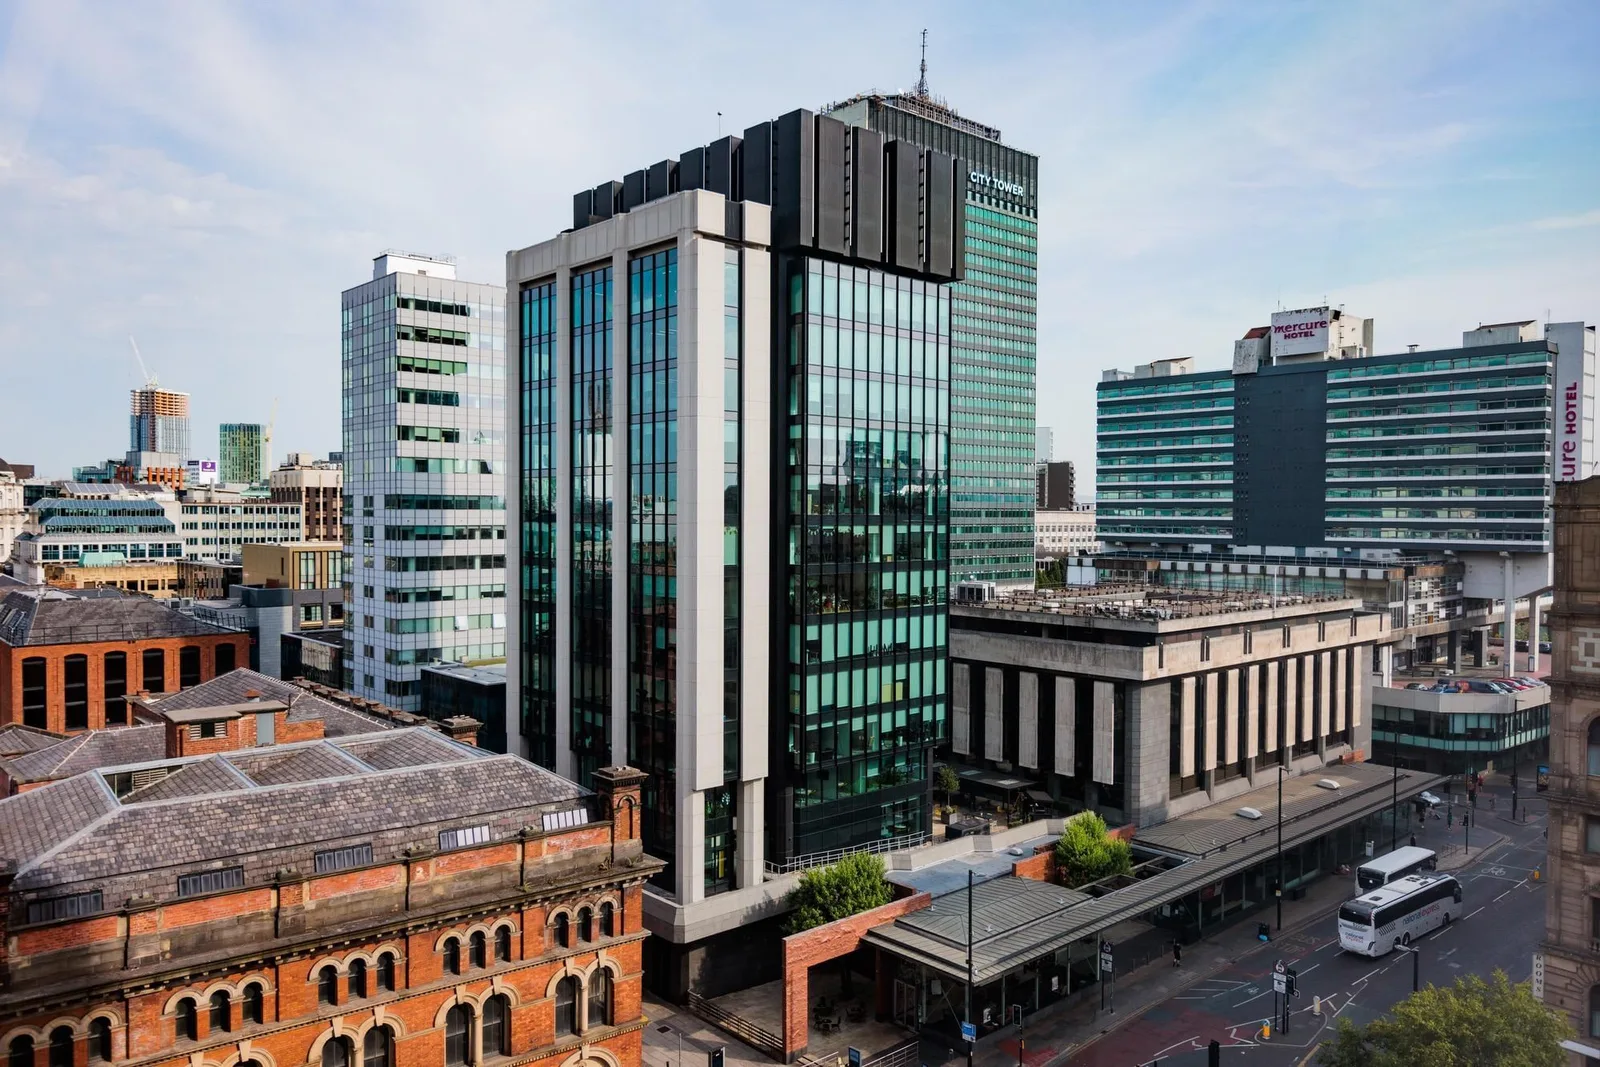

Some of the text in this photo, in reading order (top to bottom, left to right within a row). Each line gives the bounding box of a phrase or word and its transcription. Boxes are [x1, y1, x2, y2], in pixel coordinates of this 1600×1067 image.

[970, 171, 1024, 197] CITY TOWER
[1271, 320, 1328, 334] mercure
[1283, 330, 1316, 340] HOTEL
[1565, 382, 1578, 434] HOTEL
